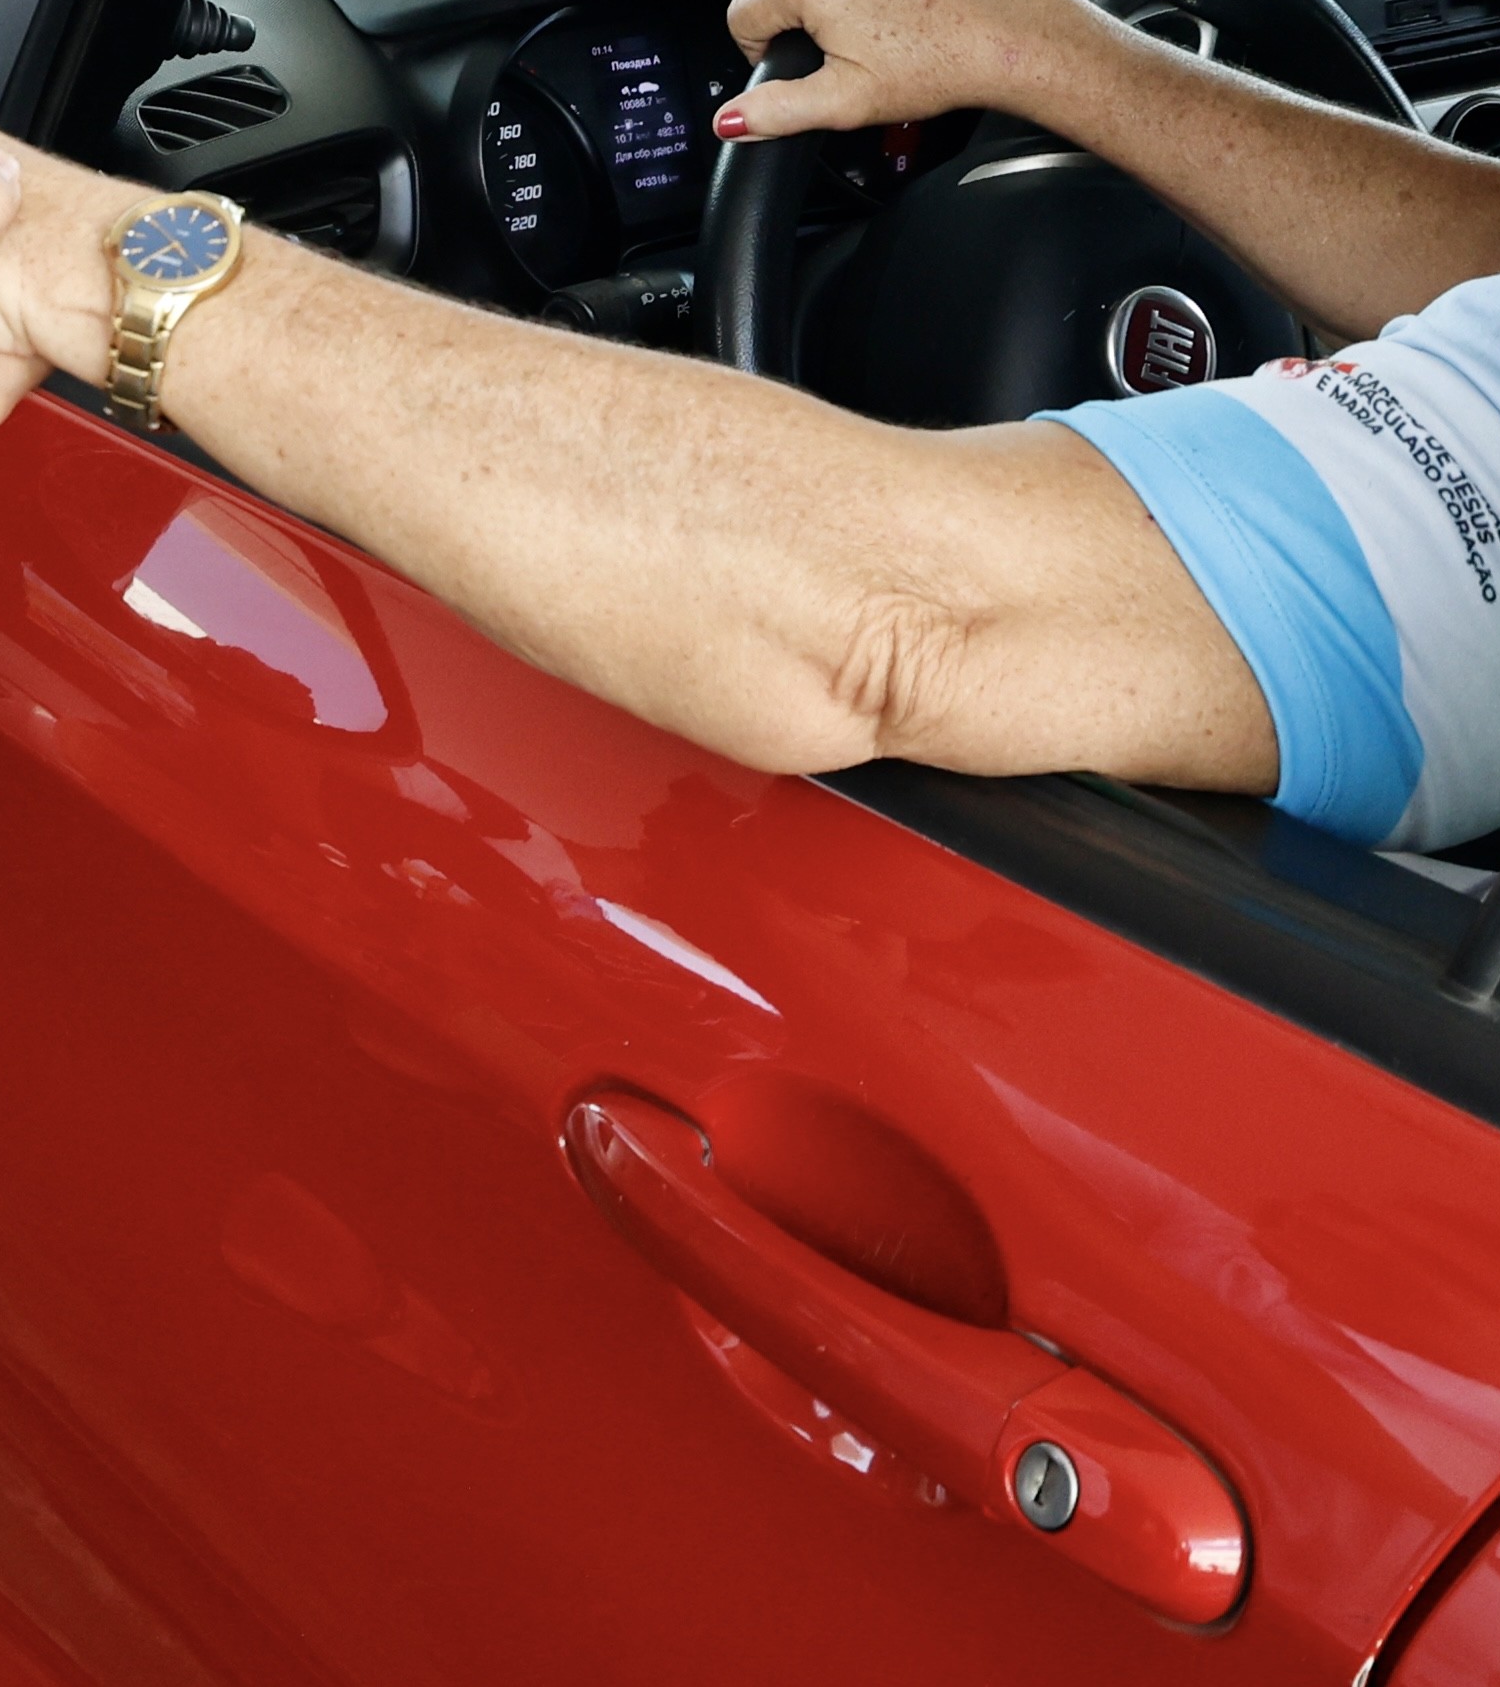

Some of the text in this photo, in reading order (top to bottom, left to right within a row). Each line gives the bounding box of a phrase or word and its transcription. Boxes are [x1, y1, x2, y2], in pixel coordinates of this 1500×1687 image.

[611, 58, 651, 72] Поездка
[499, 124, 521, 140] 160
[514, 153, 536, 169] 180
[635, 174, 667, 189] 043318
[515, 184, 542, 201] 200
[511, 215, 537, 231] 220
[1141, 309, 1195, 388] FIAT
[1316, 373, 1332, 392] E
[1329, 384, 1384, 436] MARIA
[1447, 467, 1496, 544] JESUS
[1438, 486, 1497, 604] CORAÇÃO
